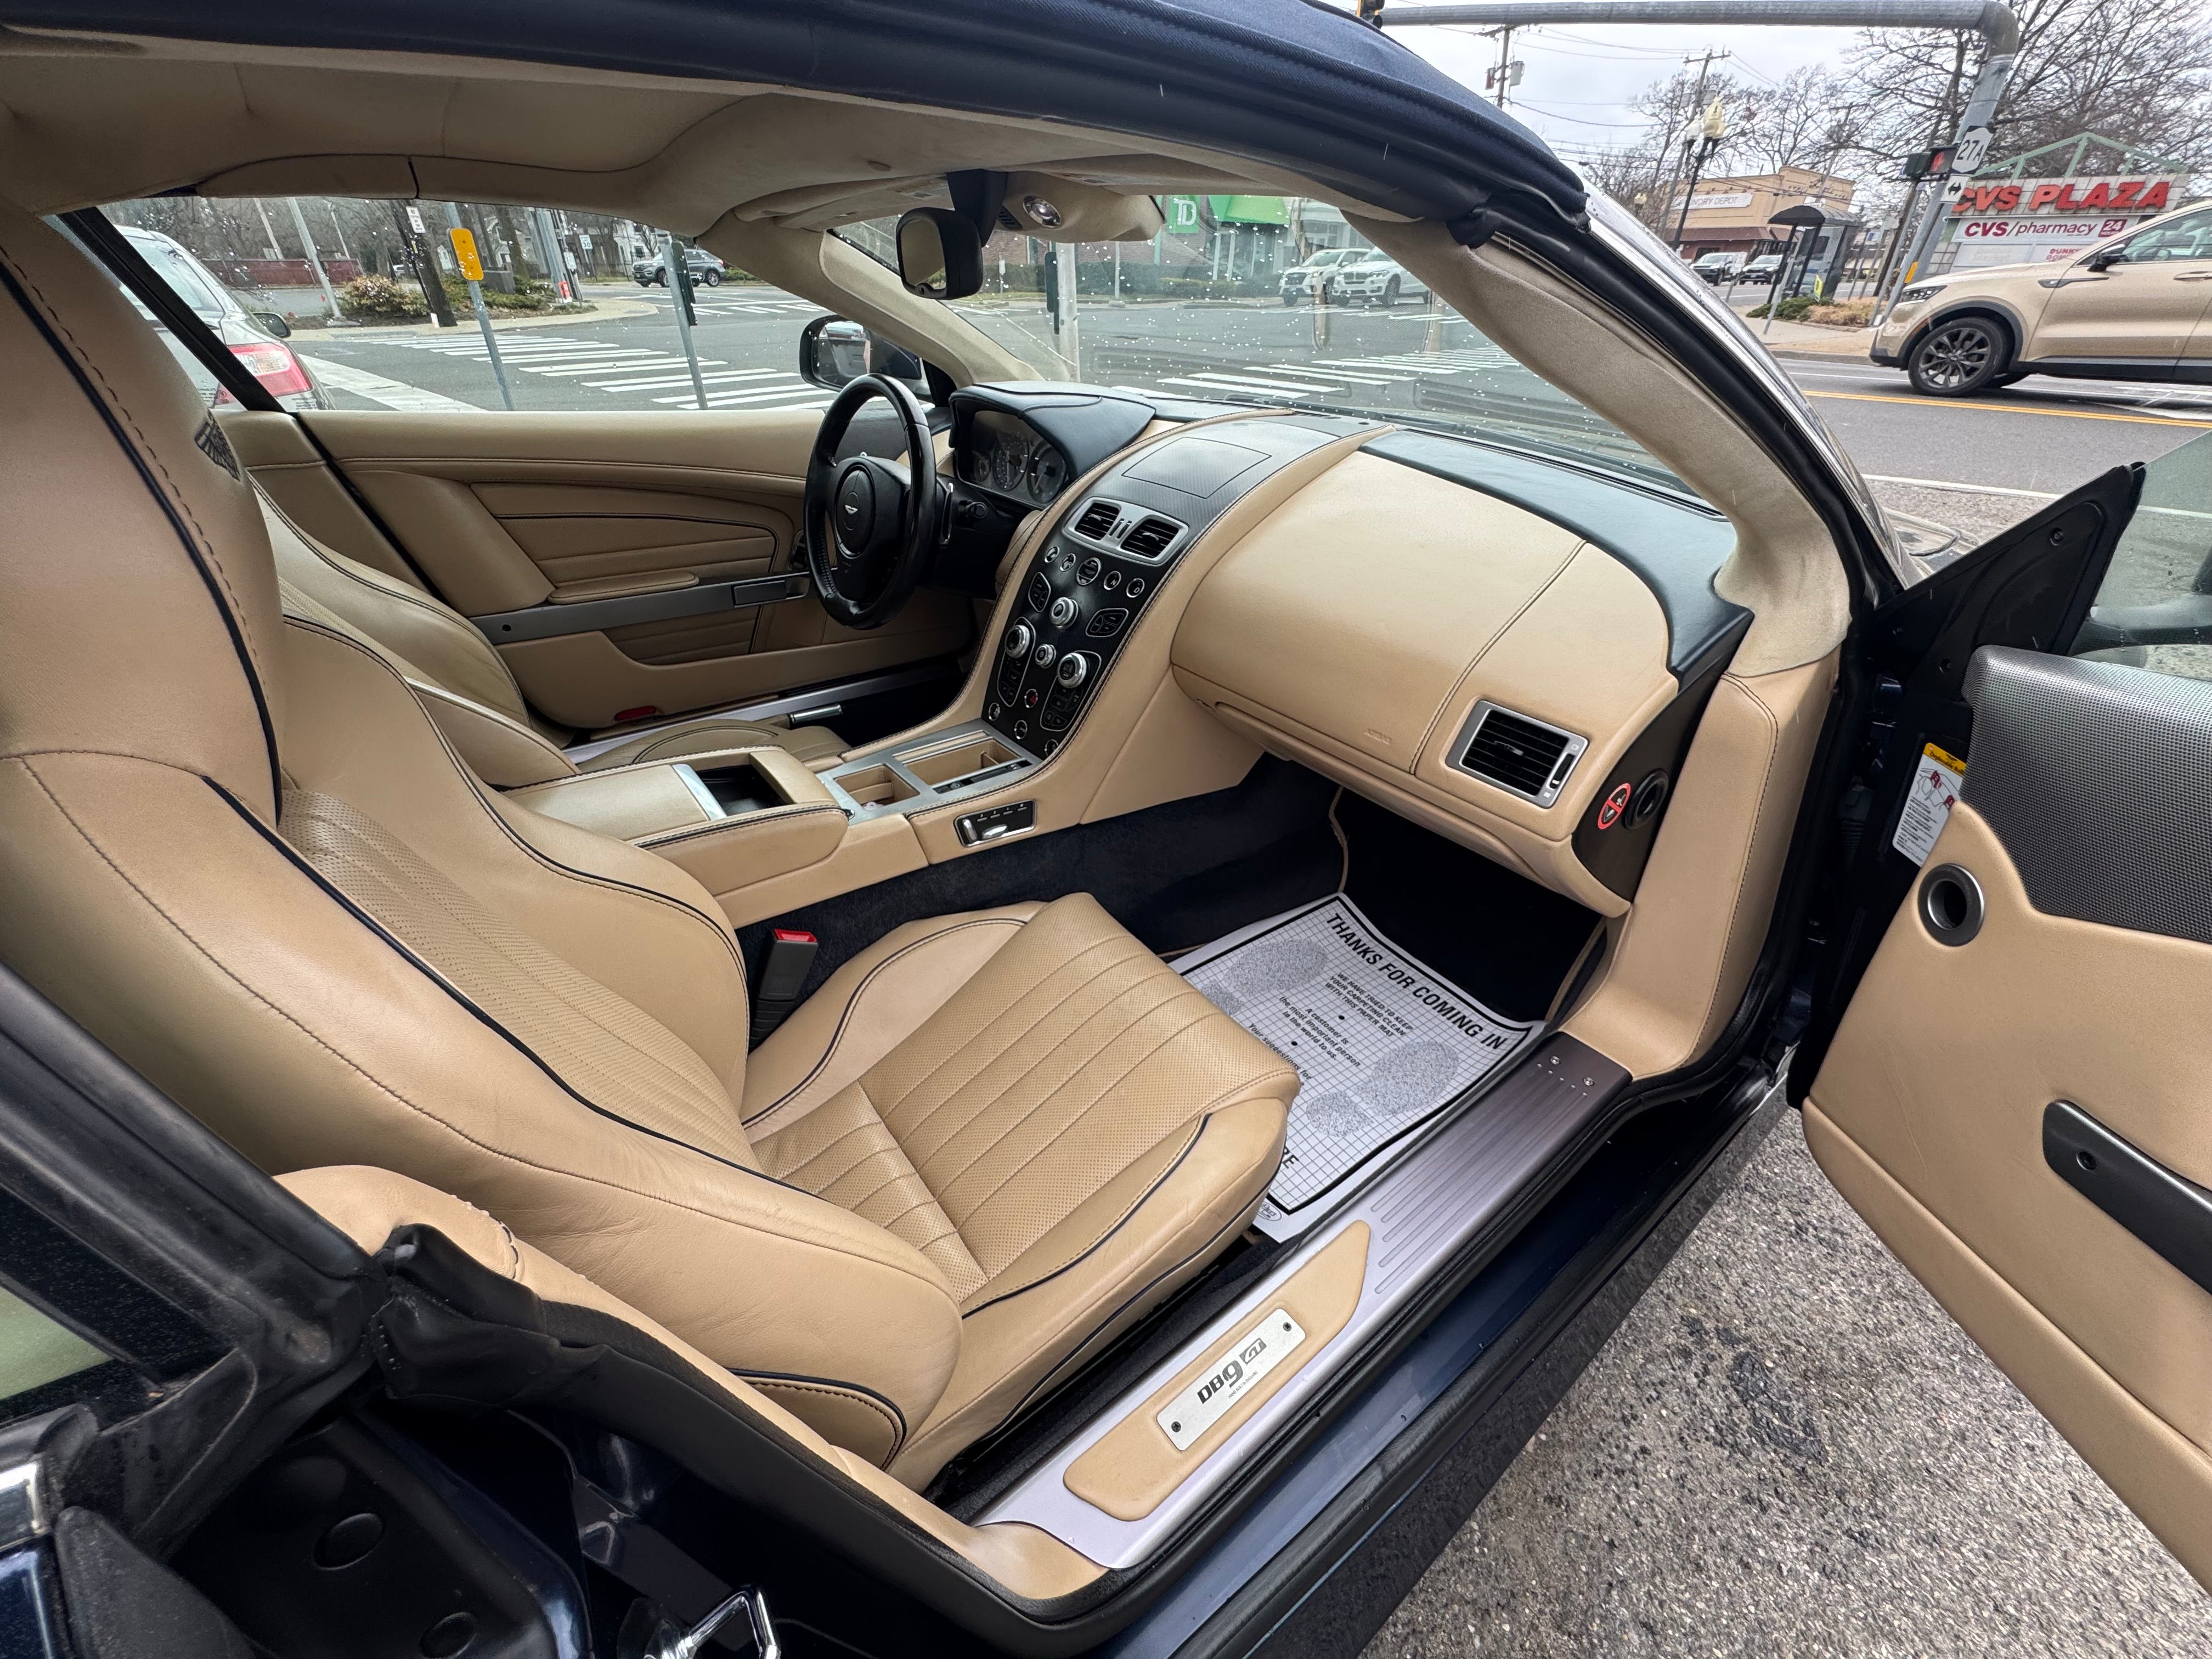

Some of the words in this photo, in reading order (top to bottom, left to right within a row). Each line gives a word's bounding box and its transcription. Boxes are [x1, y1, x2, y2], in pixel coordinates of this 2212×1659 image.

[1956, 139, 1984, 161] 27A
[1173, 198, 1197, 225] TD
[1952, 185, 2022, 211] CVS
[2029, 181, 2170, 210] PLAZA
[1965, 221, 2097, 237] CVS/pharmacy
[2103, 221, 2123, 231] 24
[1327, 913, 1383, 964] THANKS
[1378, 963, 1415, 989] FOR
[1413, 986, 1483, 1037] COMING
[1481, 1034, 1508, 1049] IN
[1338, 973, 1349, 982] WE
[1347, 981, 1365, 995] HAVE
[1365, 994, 1385, 1009] TRIED
[1384, 1008, 1395, 1017] TO
[1394, 1016, 1413, 1030] KEEP
[1311, 1014, 1342, 1038] customer
[1325, 982, 1343, 996] WITH
[1342, 995, 1358, 1008] THIS
[1357, 1007, 1379, 1025] PAPER
[1378, 1024, 1395, 1037] MAT
[1330, 976, 1348, 991] YOUR
[1347, 990, 1384, 1018] CARPETING
[1383, 1017, 1406, 1036] CLEAN
[1249, 1023, 1263, 1037] Your
[1300, 1070, 1312, 1080] for
[1279, 996, 1290, 1006] the
[1290, 1006, 1307, 1020] most
[1305, 1019, 1338, 1047] important
[1335, 1046, 1361, 1066] person
[1289, 1017, 1301, 1028] the
[1300, 1027, 1321, 1043] world
[1197, 1360, 1244, 1404] DB9
